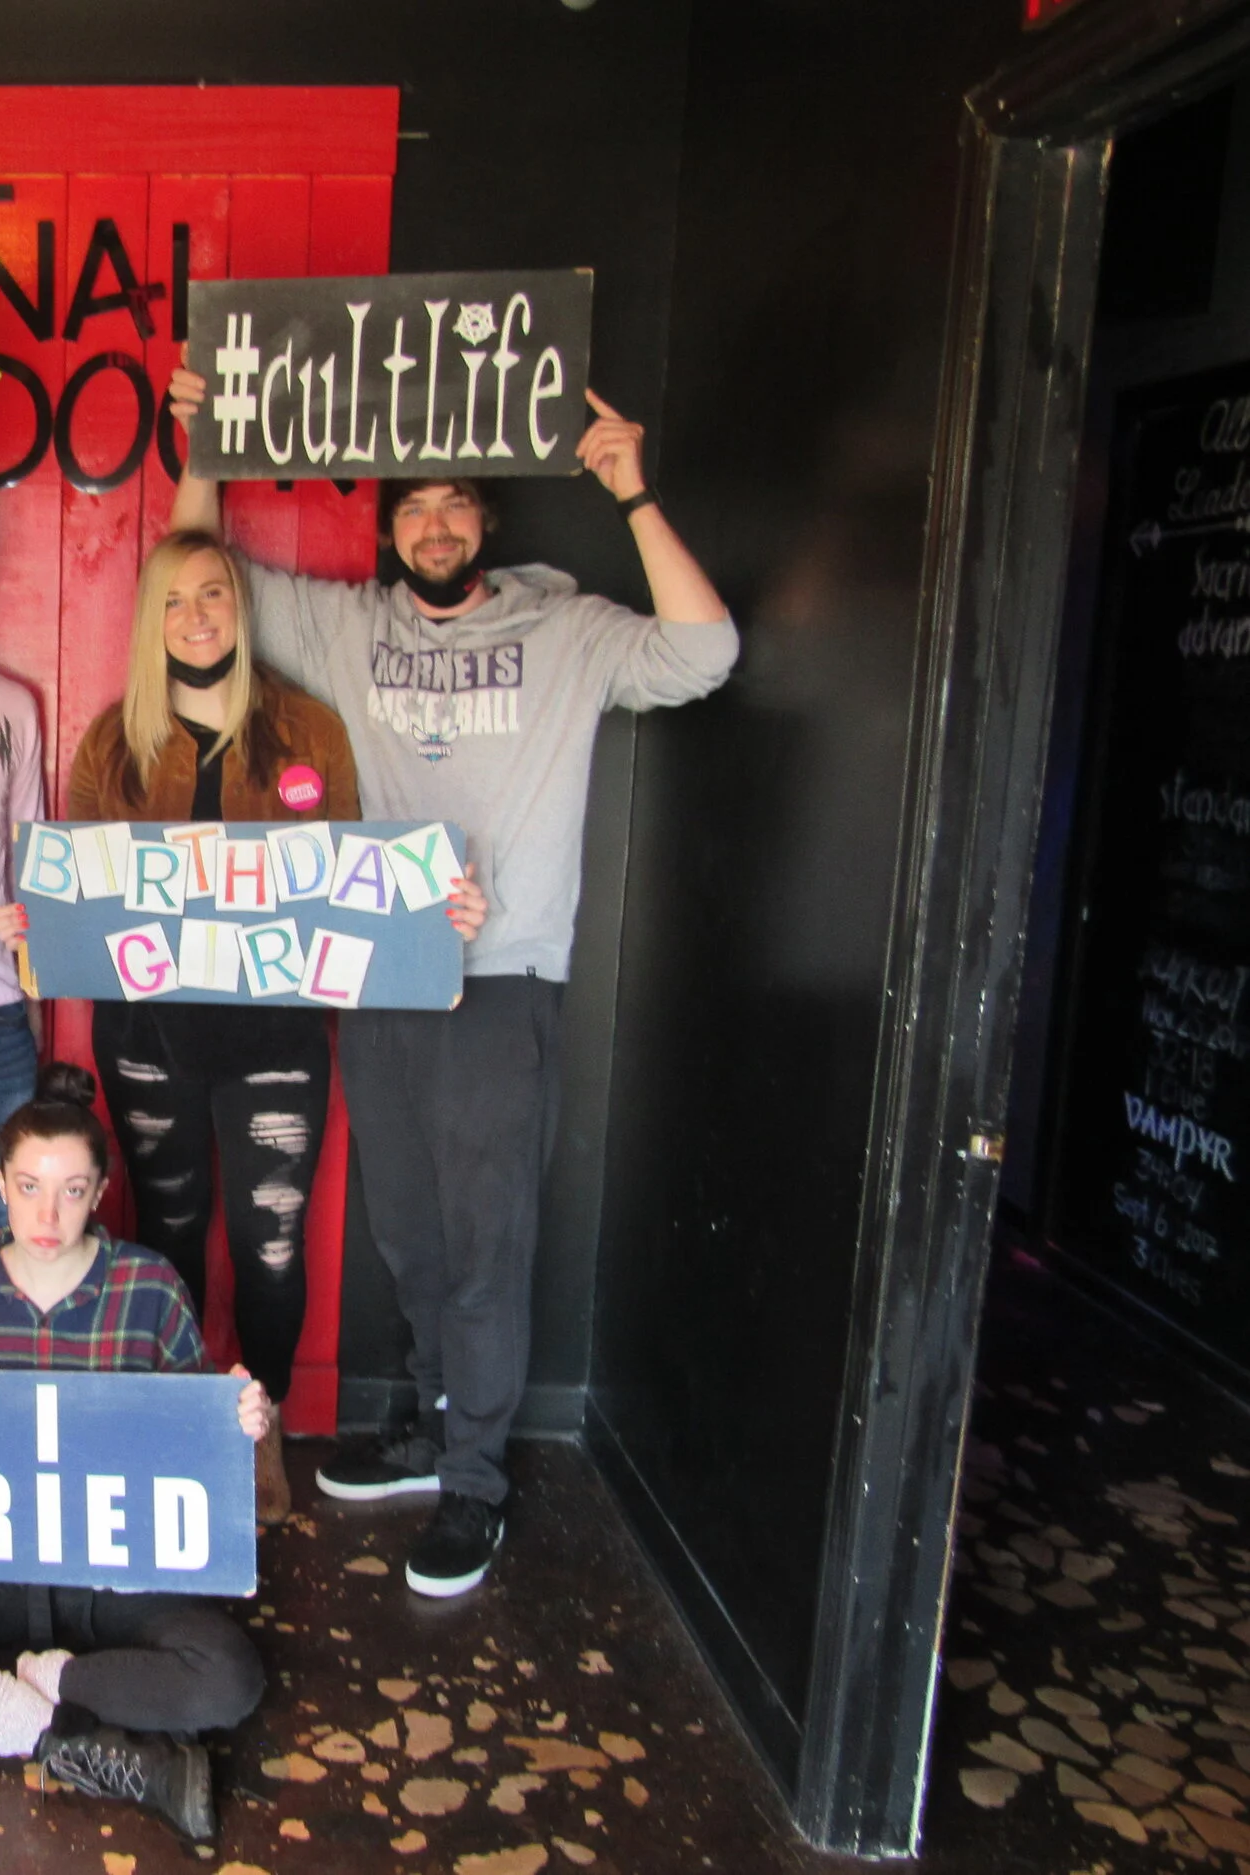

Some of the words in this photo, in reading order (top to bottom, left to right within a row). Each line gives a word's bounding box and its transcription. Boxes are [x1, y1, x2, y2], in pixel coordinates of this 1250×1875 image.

[30, 826, 440, 910] BIRTHDAY
[117, 924, 351, 1000] GIRL
[35, 1383, 59, 1464] I
